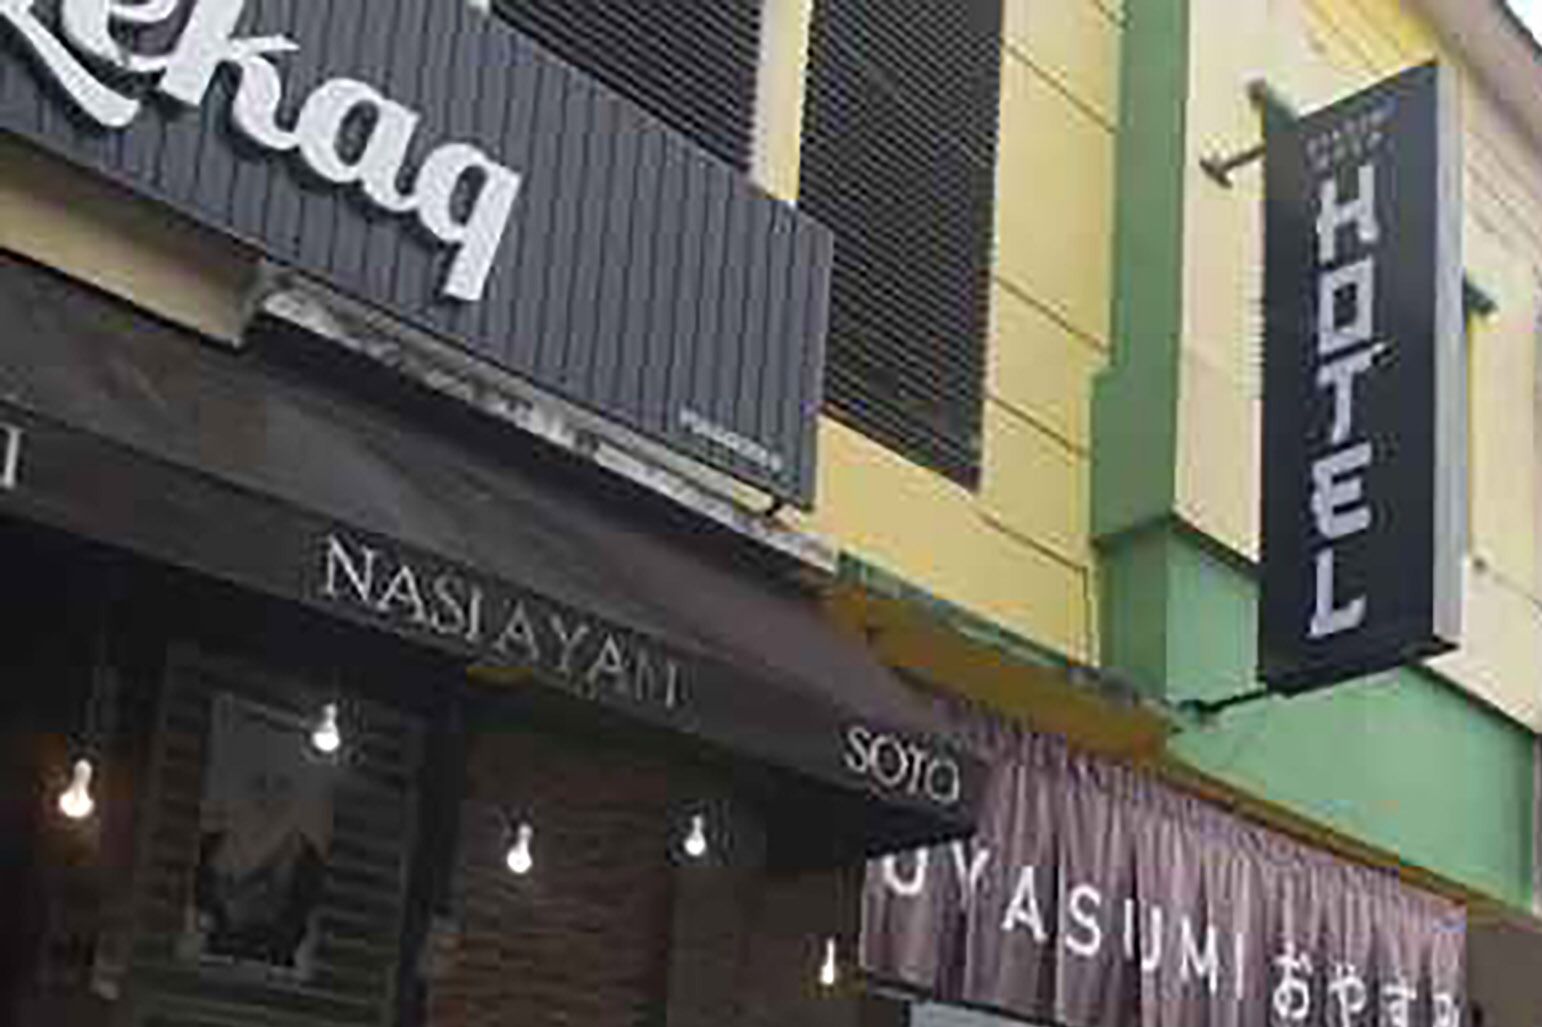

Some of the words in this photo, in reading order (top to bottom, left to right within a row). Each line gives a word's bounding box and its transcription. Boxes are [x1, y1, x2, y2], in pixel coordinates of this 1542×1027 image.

[0, 0, 522, 302] ekaq
[1310, 163, 1385, 638] HOTEL
[325, 533, 484, 643] NASI
